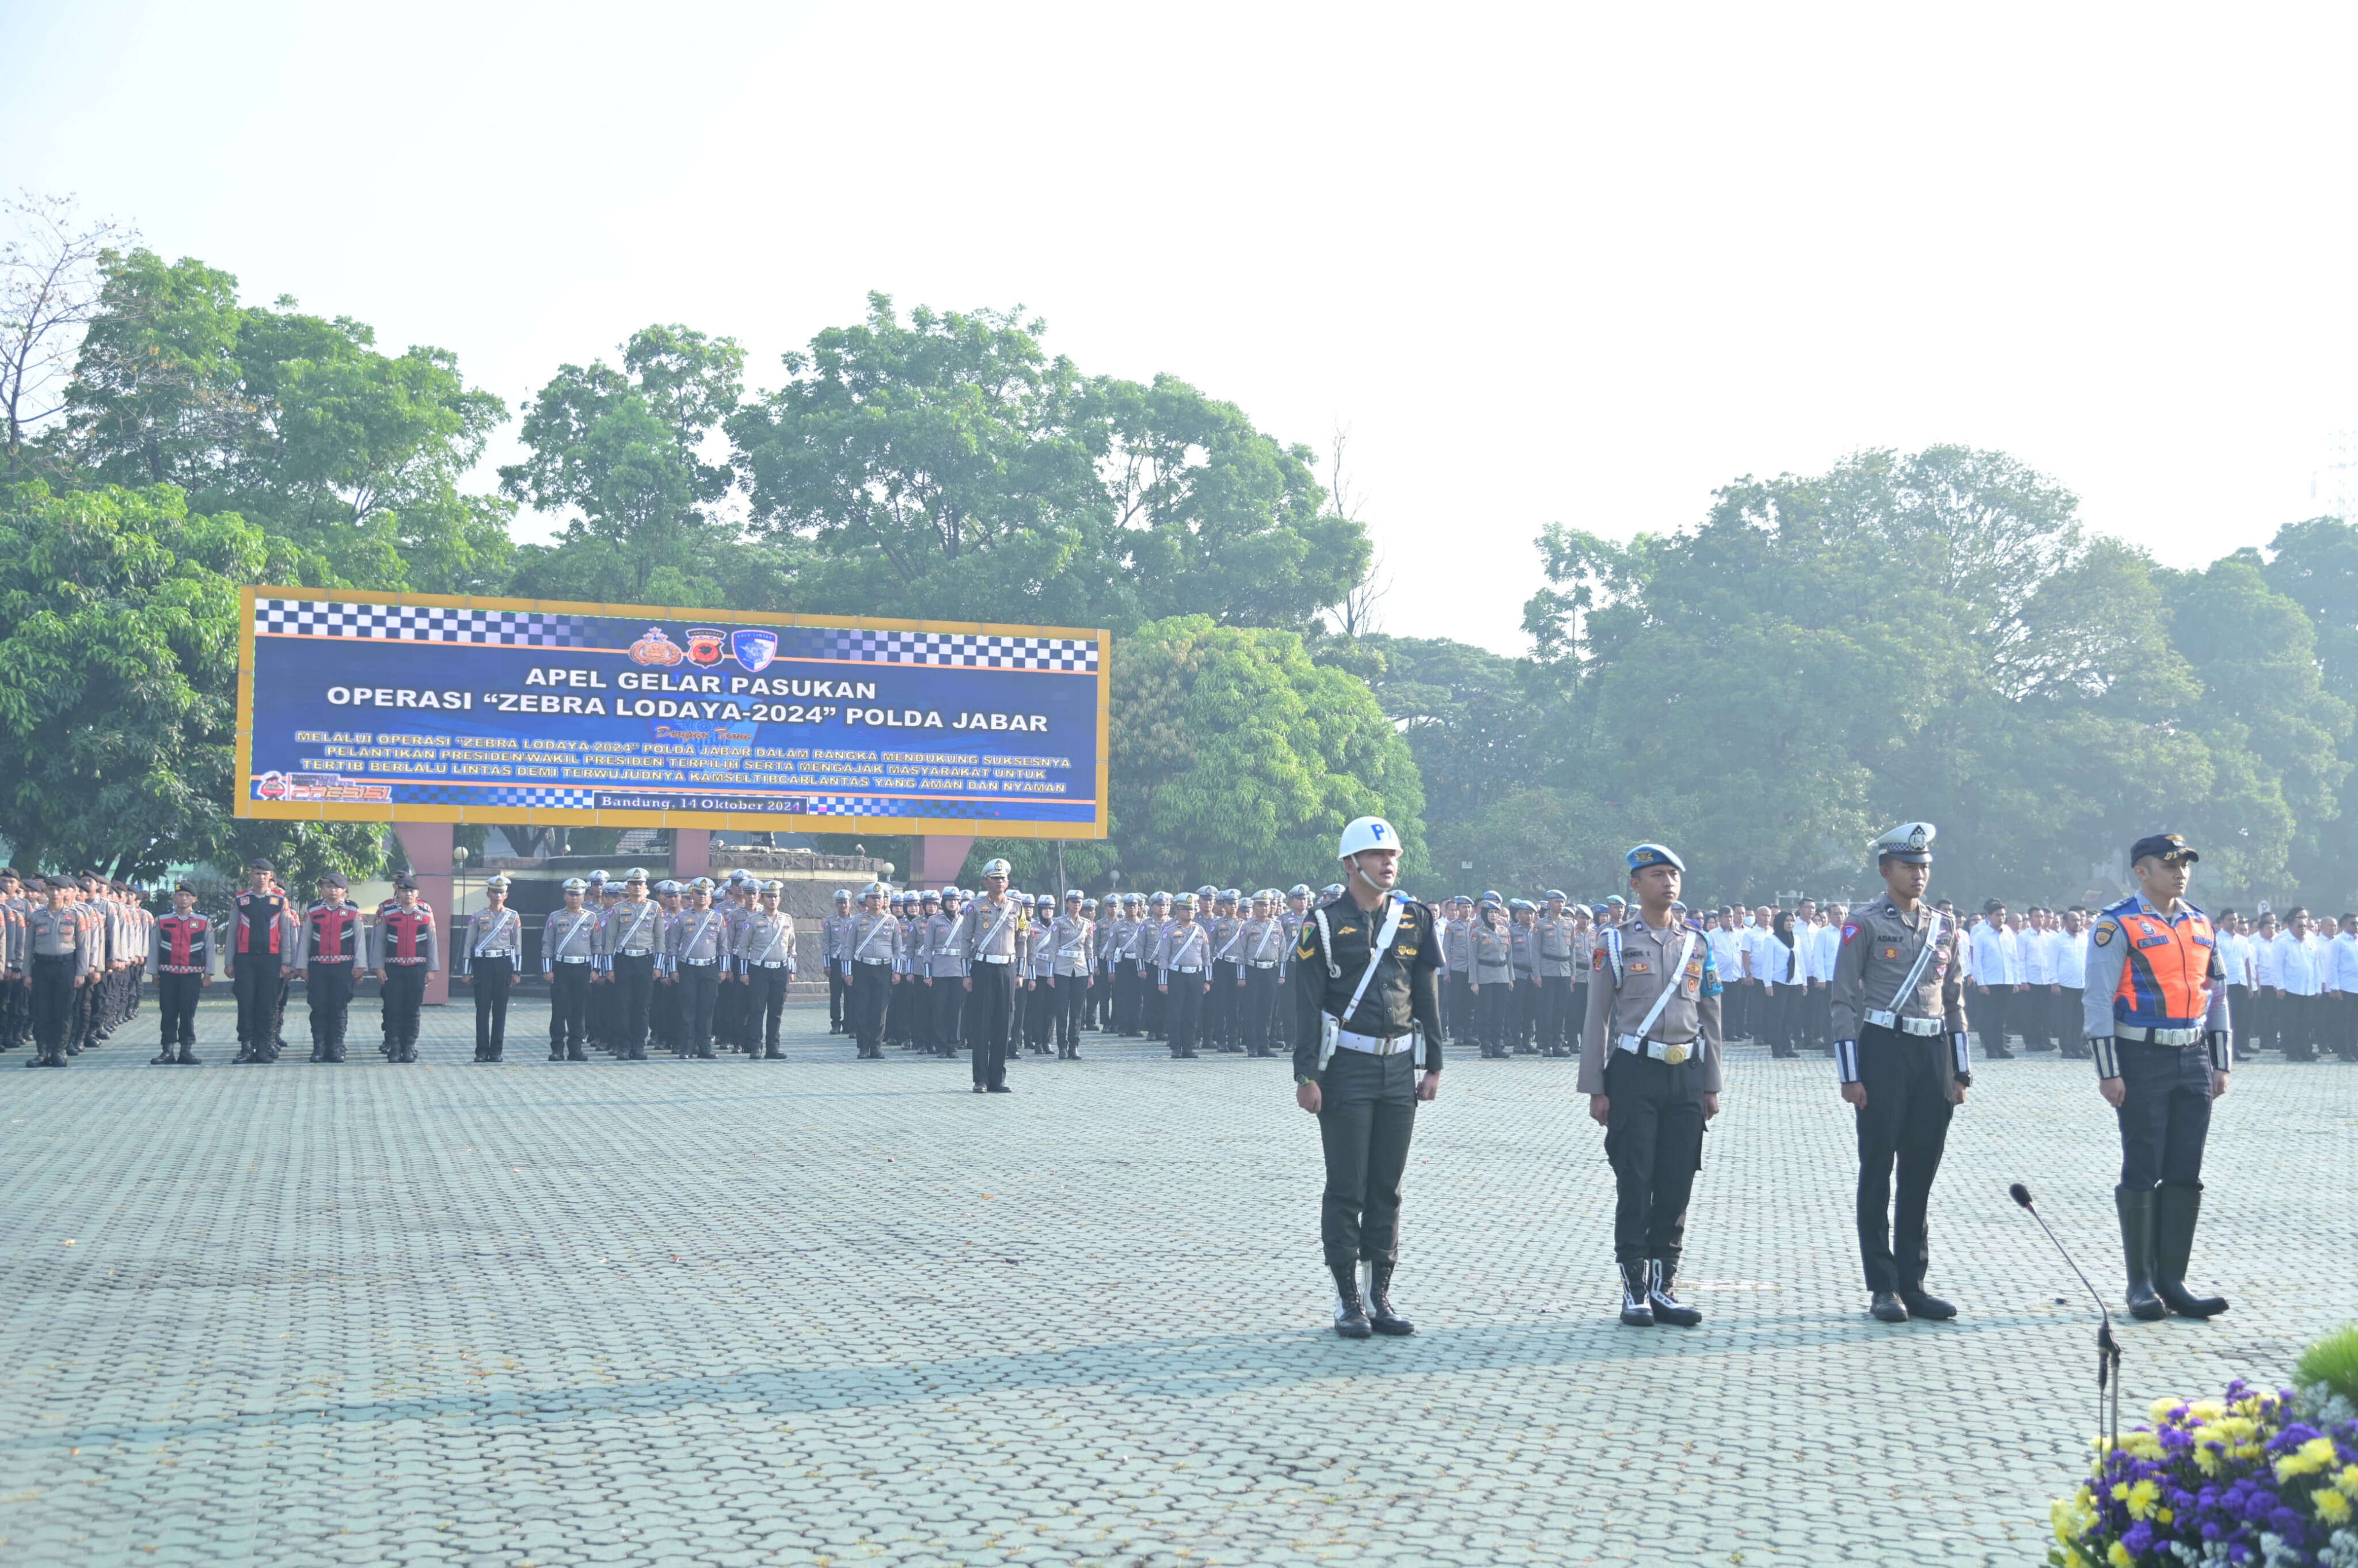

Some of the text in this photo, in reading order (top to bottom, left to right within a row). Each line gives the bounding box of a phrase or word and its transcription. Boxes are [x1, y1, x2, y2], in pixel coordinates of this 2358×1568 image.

[525, 668, 876, 699] APEL GELAR PASUKAN
[327, 686, 1048, 732] OPERASI “ZEBRA LODAYA-2024” POLDA JABAR
[296, 731, 372, 744] MELALUI
[378, 734, 451, 747] OPERASI
[644, 744, 695, 755] POLDA
[700, 747, 751, 757] JABAR
[756, 748, 809, 759] DALAM
[813, 750, 878, 762] RANGKA
[882, 752, 978, 764] MENDUKUNG
[983, 755, 1071, 768] SUKSESNYA
[326, 746, 1047, 779] PELANTIKAN PRESIDEN/WAKIL PRESIDEN TERPILIH SERTA MENGAJAK MASYARAKAT UNTUK
[291, 785, 390, 799] PRESISI
[301, 759, 1066, 793] TERTIB BERLALU LINTAS DEMI TERWUJUDNYA KAMSELTIBCARLANTAS YANG AMAN DAN NYAMAN
[602, 796, 801, 811] Bandung, 14 Oktober 2024
